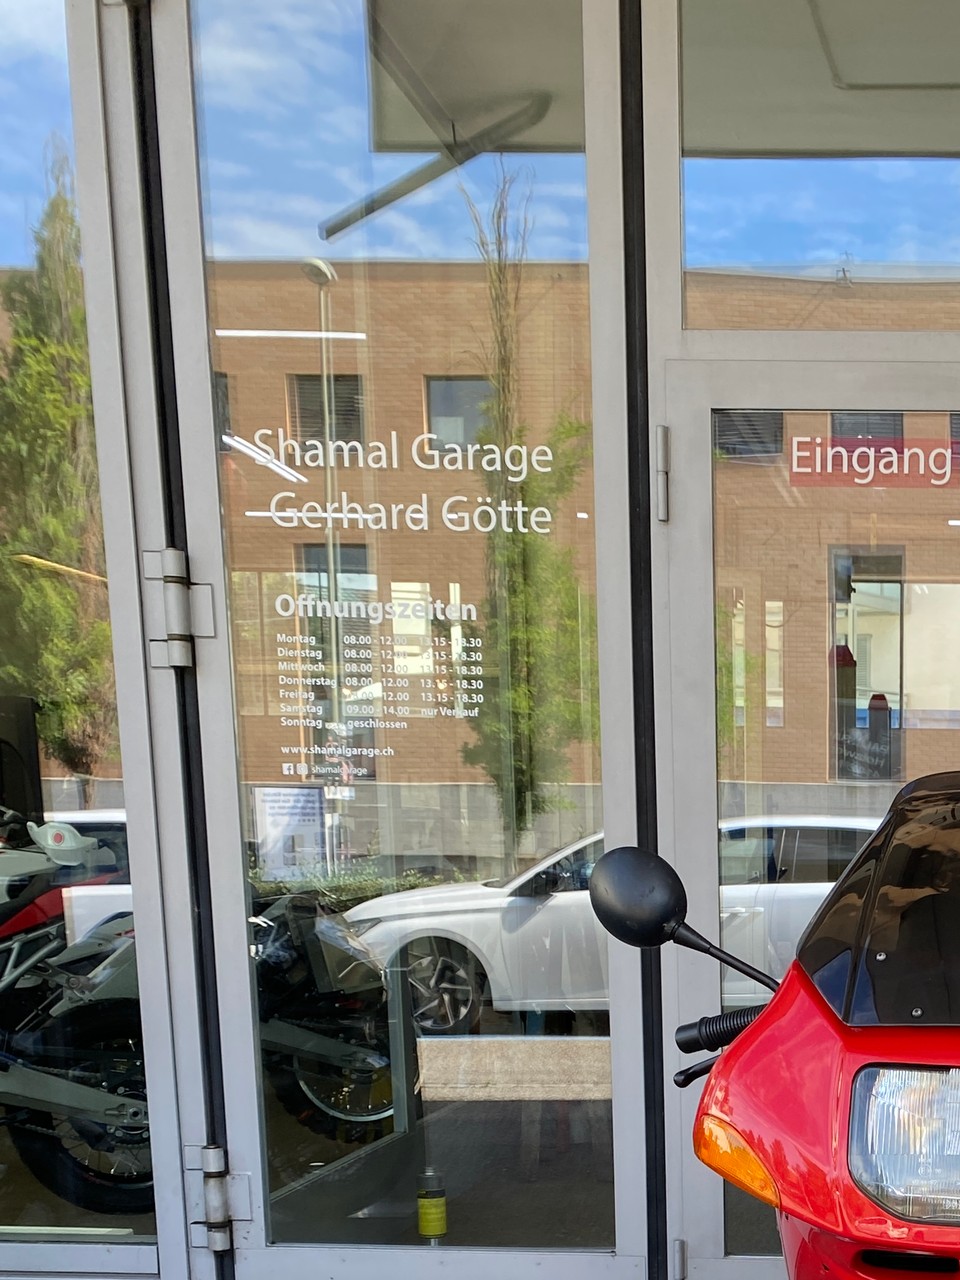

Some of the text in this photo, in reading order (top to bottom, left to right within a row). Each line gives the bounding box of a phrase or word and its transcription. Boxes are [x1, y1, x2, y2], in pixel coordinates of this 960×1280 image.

[253, 428, 553, 483] Shamal Garage
[791, 436, 952, 486] Eingang
[269, 491, 552, 534] Gerhard Götte
[276, 634, 316, 646] Montag
[343, 635, 372, 645] 08.00
[380, 636, 407, 645] 12.00
[455, 638, 482, 647] 18.30
[277, 648, 322, 659] Dienstag
[344, 649, 372, 658] 08.00
[381, 650, 408, 659] 12.00
[455, 652, 482, 661] 18.30
[278, 662, 325, 671] Mittwoch
[344, 663, 373, 672] 08.00
[381, 664, 408, 673] 12.00
[420, 665, 447, 674] 13.15
[456, 666, 483, 675] 18.30
[279, 676, 337, 688] Donnerstag
[345, 677, 373, 686] 08.00
[382, 678, 409, 687] 12.00
[420, 679, 447, 688] 13.15
[456, 680, 483, 689] 18.30
[279, 690, 315, 700] Freitag
[383, 692, 409, 701] 12.00
[421, 693, 448, 702] 13.15
[456, 694, 484, 703] 18.30
[280, 704, 323, 714] Samstag
[346, 705, 374, 714] 09.00
[383, 706, 410, 715] 14.00
[421, 708, 438, 716] nur
[439, 707, 480, 717] Verkauf
[280, 717, 408, 729] Sonntag geschlossen
[280, 745, 395, 757] www.shamalgarage.ch
[311, 765, 368, 776] shamalgarage
